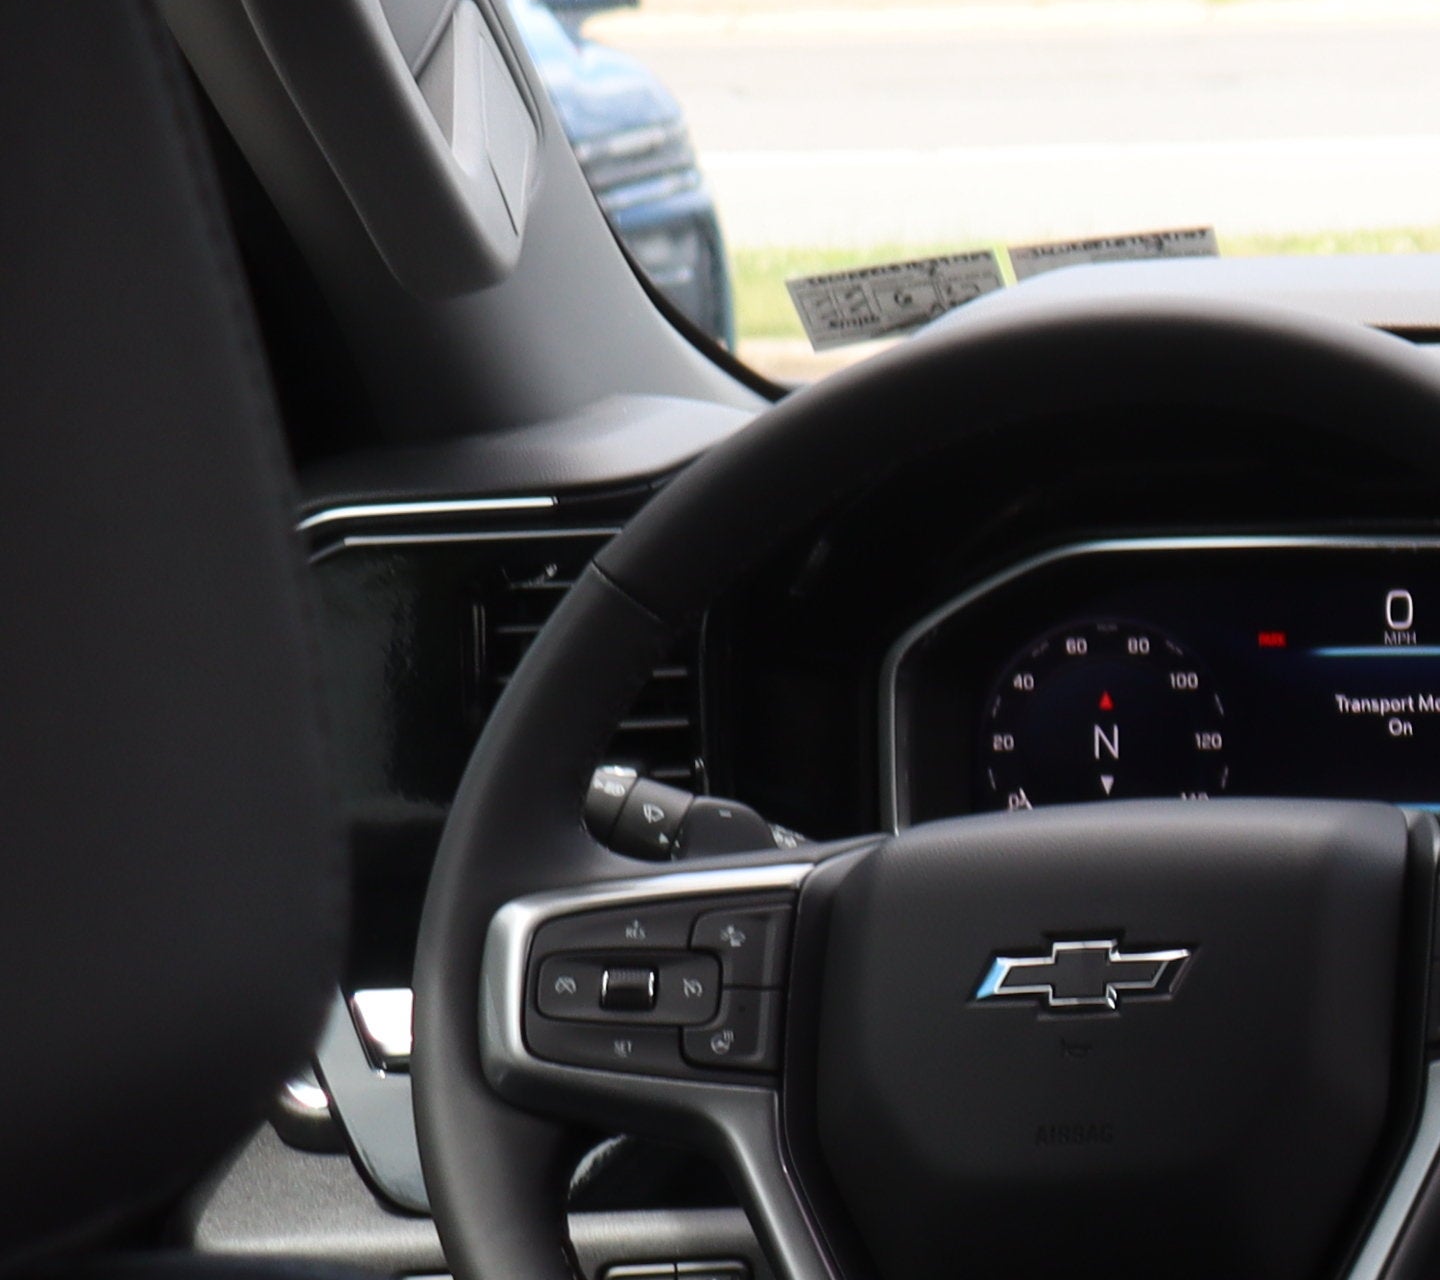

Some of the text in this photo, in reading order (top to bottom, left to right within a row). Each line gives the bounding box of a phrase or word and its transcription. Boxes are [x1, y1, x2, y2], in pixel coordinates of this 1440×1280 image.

[1386, 589, 1413, 630] 0
[1066, 638, 1087, 655] 60
[1128, 638, 1150, 655] 80
[1384, 631, 1416, 645] MPH
[1013, 674, 1034, 691] 40
[1170, 672, 1198, 690] 100
[1335, 693, 1415, 716] Transport
[1389, 718, 1413, 736] On
[993, 734, 1014, 751] 20
[1094, 724, 1119, 760] N
[1195, 733, 1222, 750] 120
